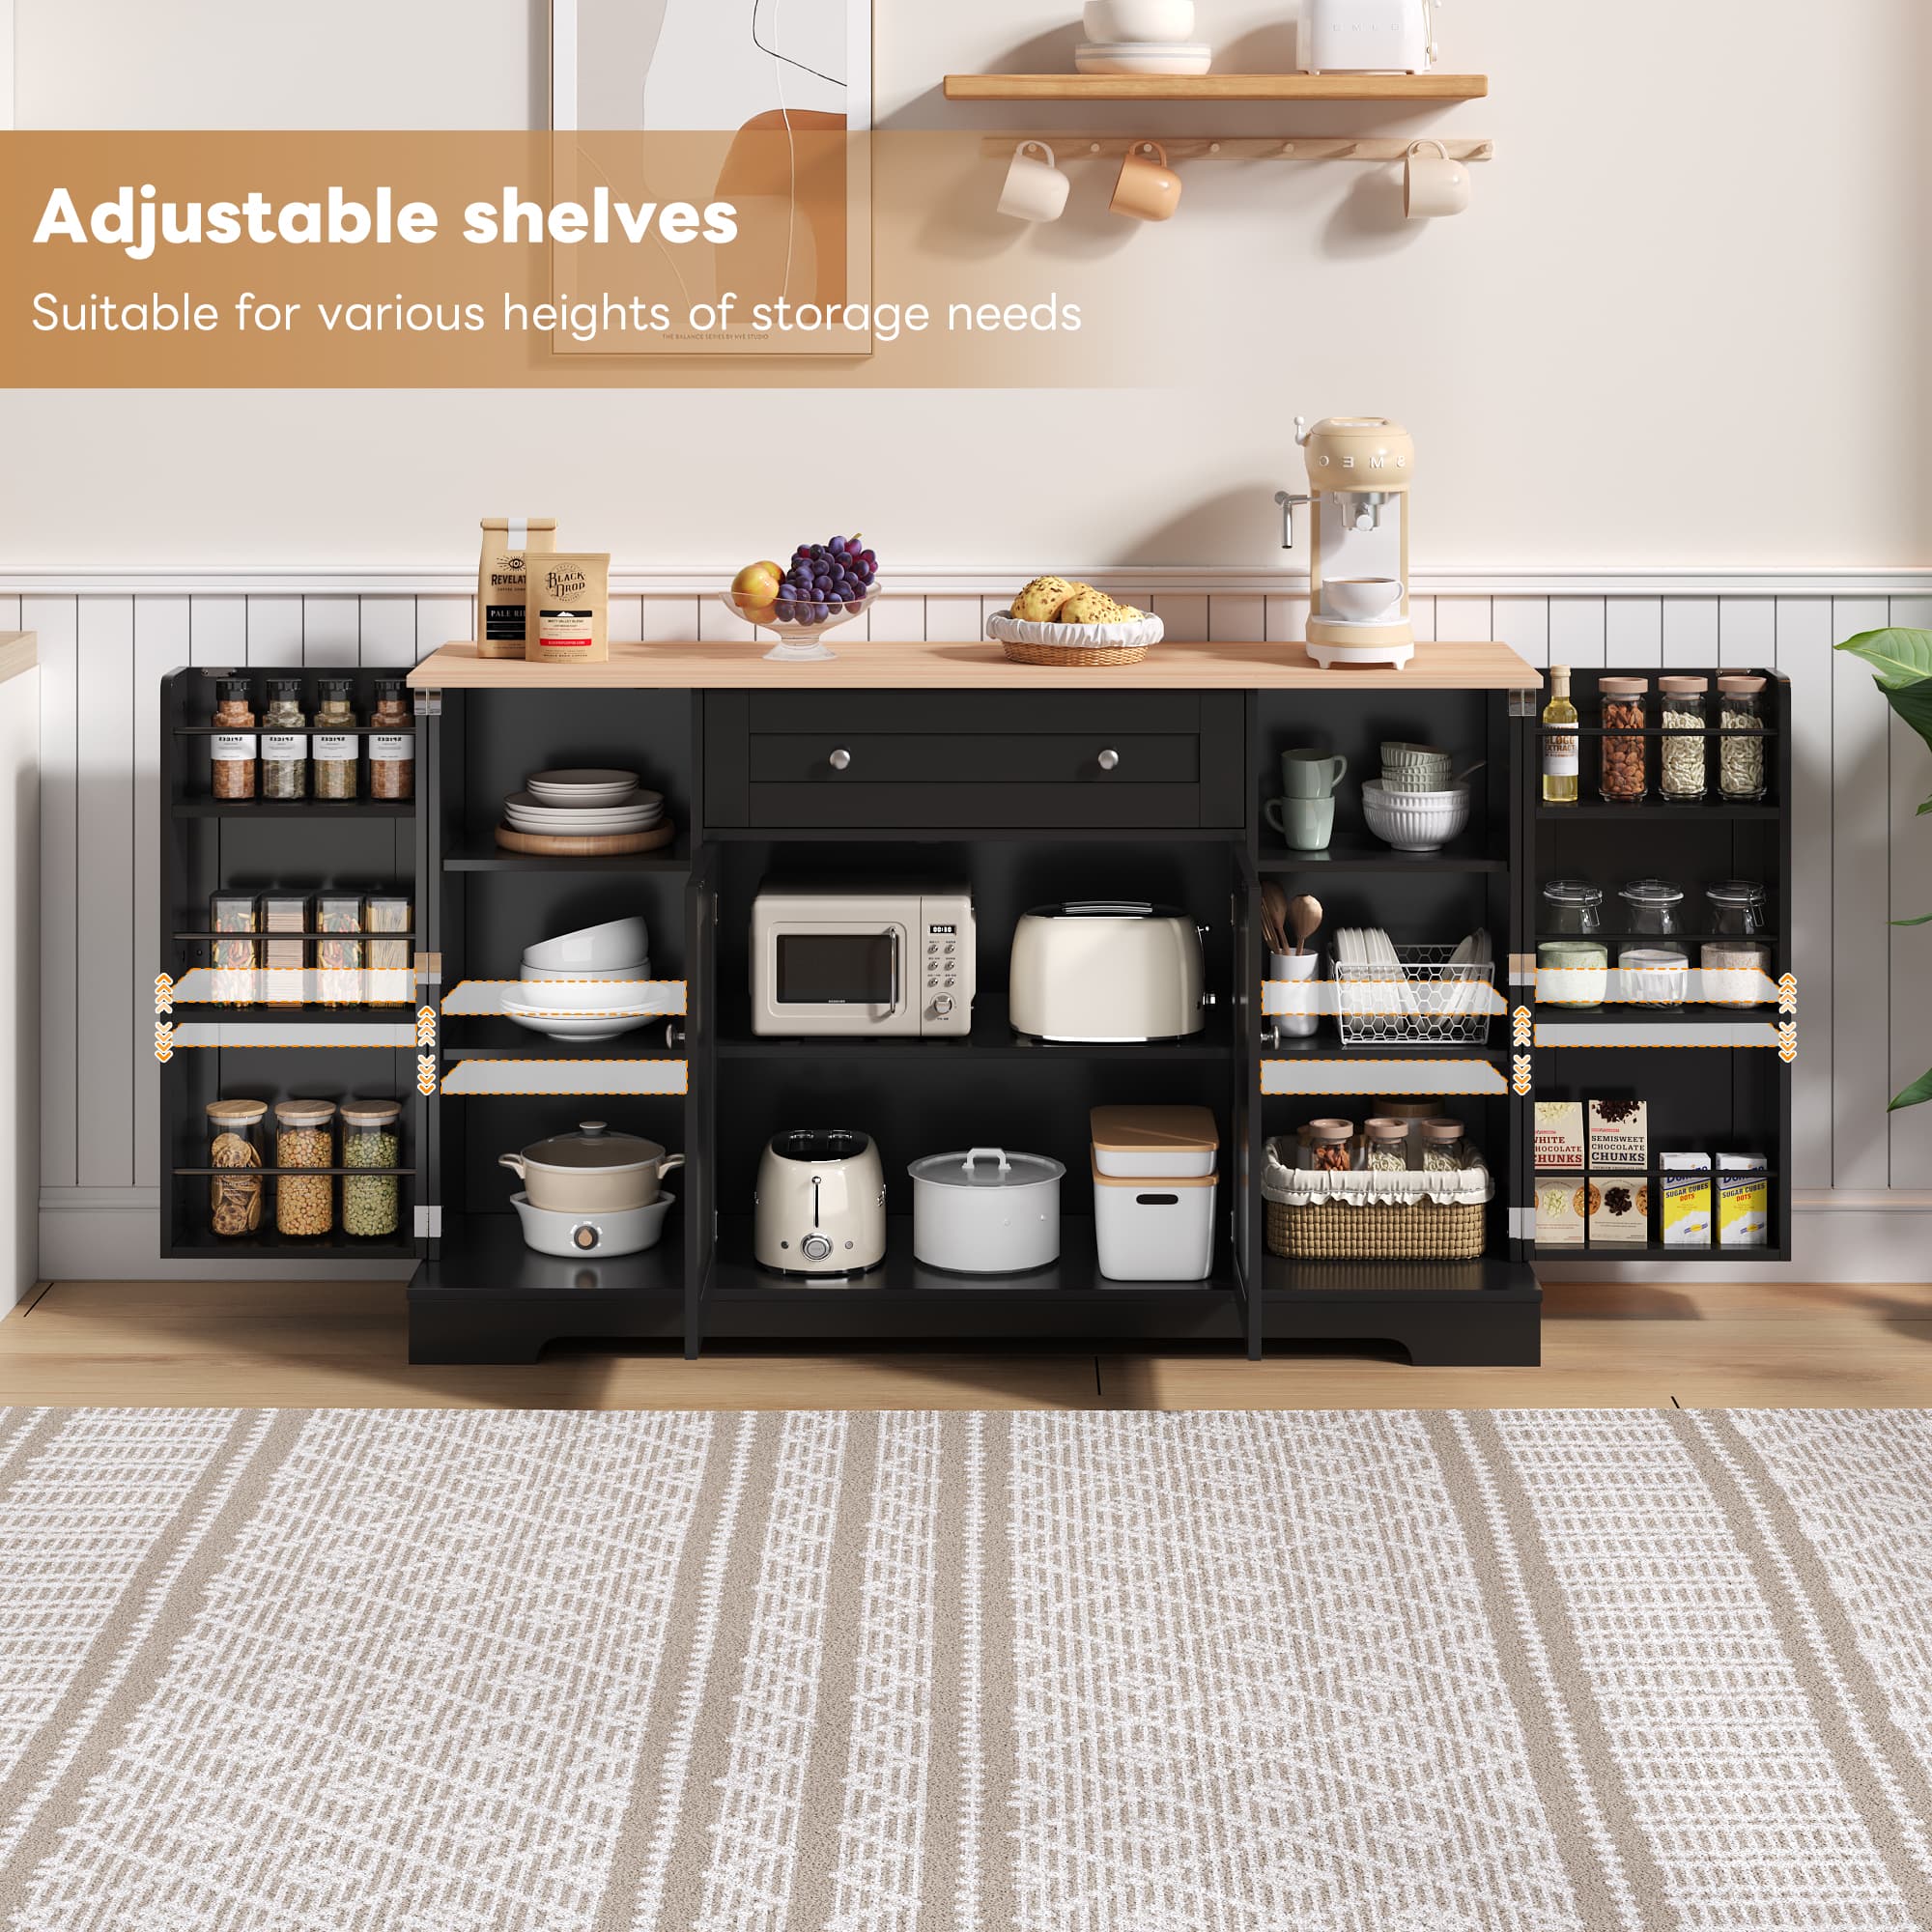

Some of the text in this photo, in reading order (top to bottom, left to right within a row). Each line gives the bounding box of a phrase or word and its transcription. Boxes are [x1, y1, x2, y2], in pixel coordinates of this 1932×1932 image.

[547, 571, 585, 589] BLACK
[551, 582, 585, 597] DROP
[1534, 1154, 1582, 1163] HUNKS
[1591, 1151, 1645, 1162] CHUNKS
[1665, 1182, 1709, 1199] SUGAR CUBES
[1679, 1192, 1695, 1202] DOTS
[1722, 1182, 1765, 1199] SUGAR CUBES
[1736, 1193, 1751, 1202] DOTS
